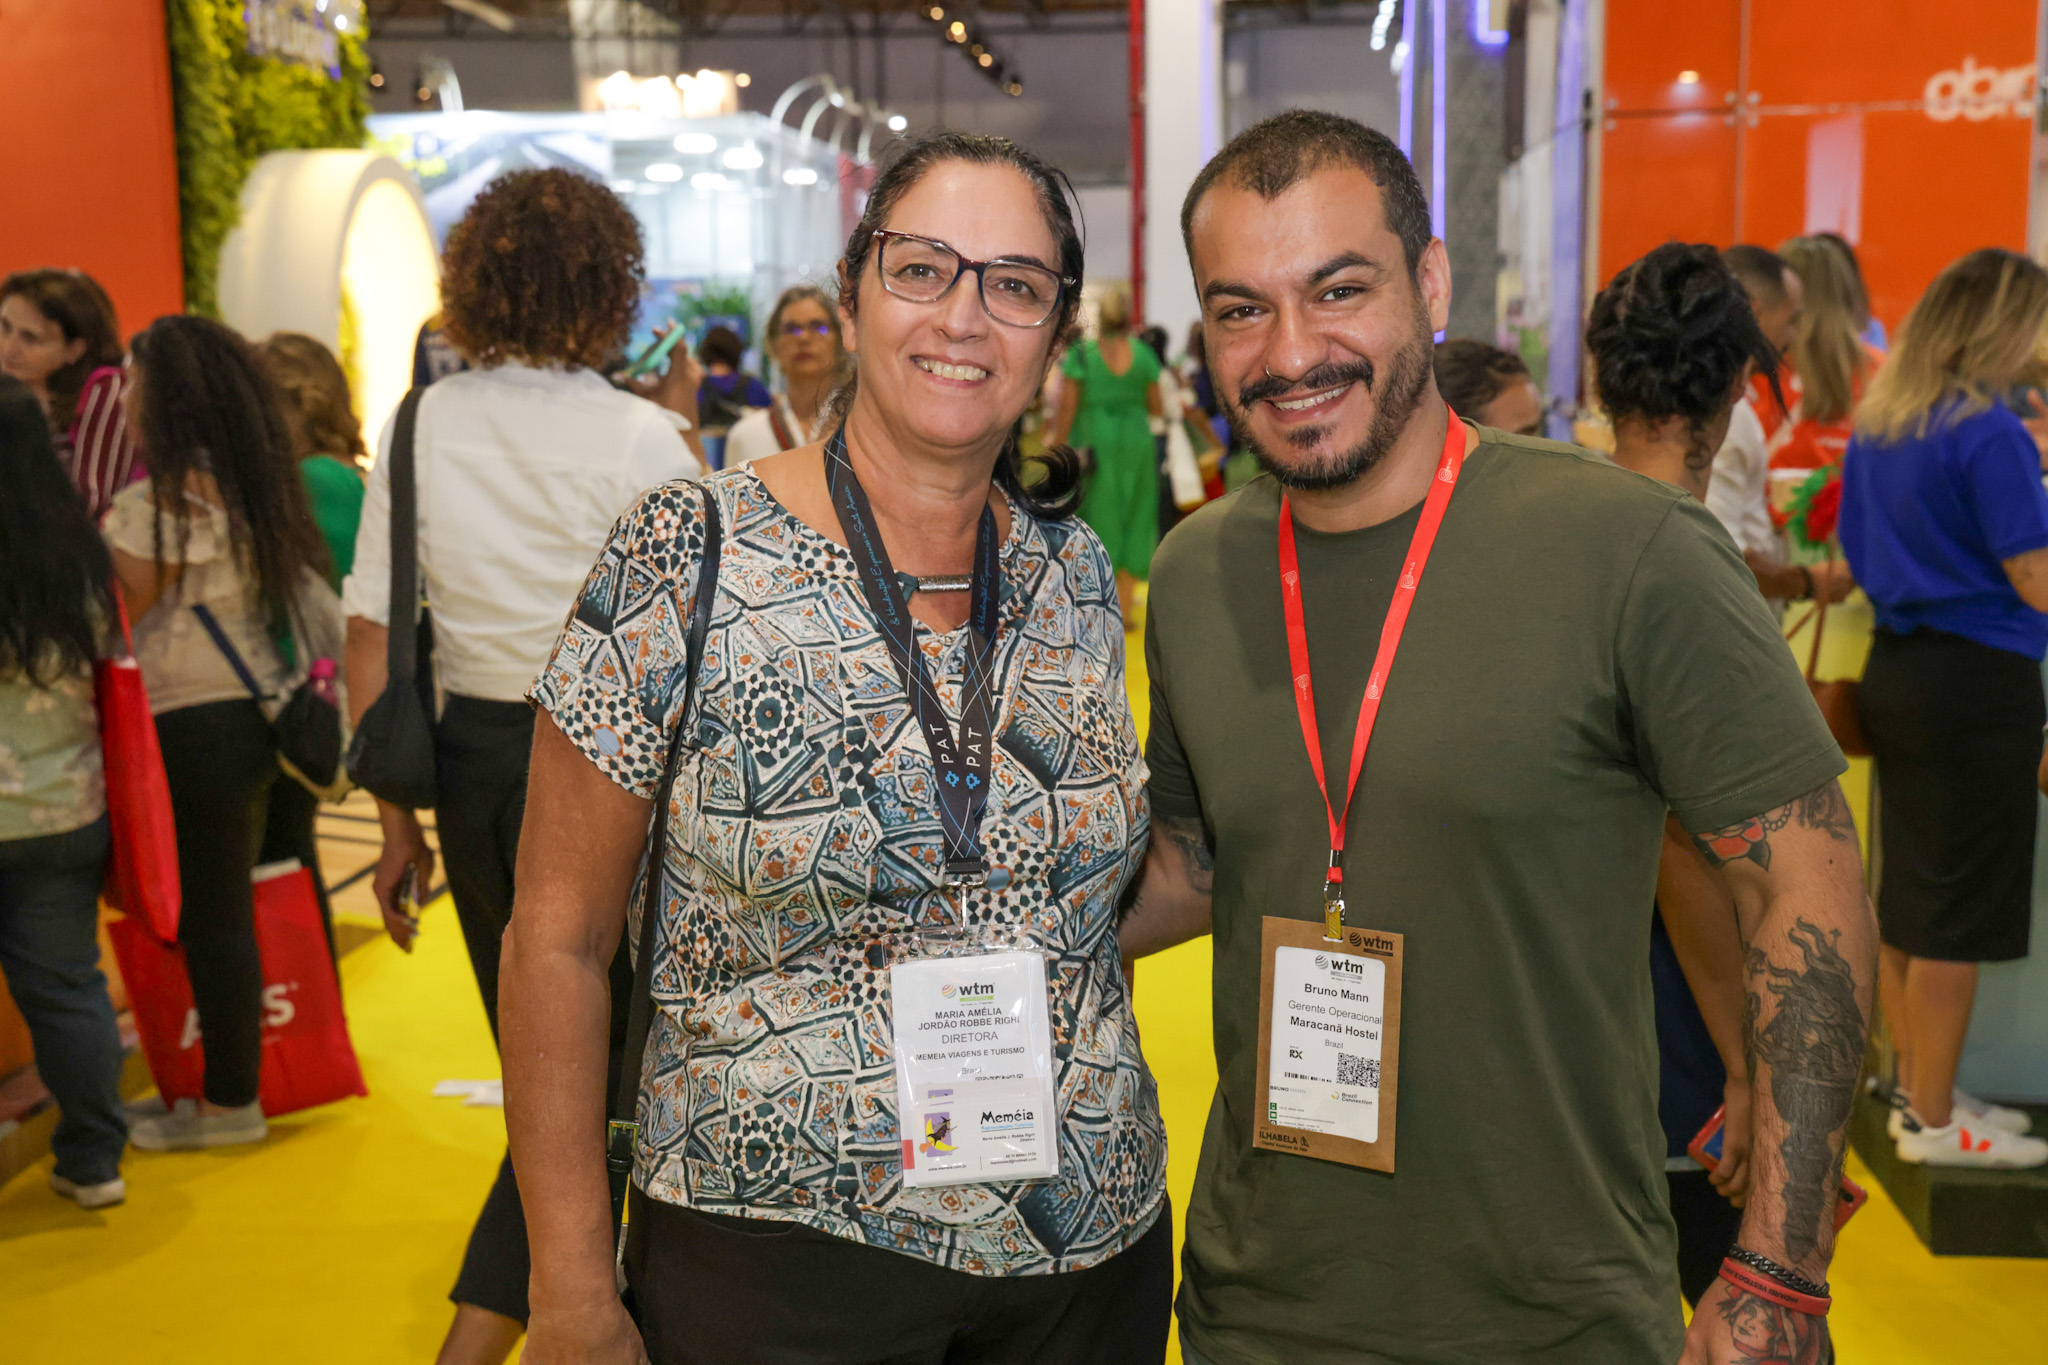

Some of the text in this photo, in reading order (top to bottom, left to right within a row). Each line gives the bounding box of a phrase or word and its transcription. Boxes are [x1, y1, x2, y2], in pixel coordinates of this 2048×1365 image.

[844, 485, 858, 513] America
[852, 512, 865, 533] South
[865, 539, 883, 576] Experiences
[875, 577, 895, 616] Handcrafted
[929, 723, 954, 763] PAT
[966, 726, 982, 767] PAT
[1363, 936, 1393, 951] wtm
[1331, 959, 1363, 974] wtm
[959, 982, 994, 996] wtm
[1304, 983, 1369, 1003] Bruno Mann
[935, 1006, 1002, 1020] MARIA AMÉLIA
[1288, 1000, 1382, 1025] Gerente Operacional
[918, 1016, 1020, 1030] JORDÃO ROBBE RIGHI
[1290, 1016, 1378, 1040] Maracanã Hostel
[941, 1031, 998, 1044] DIRETORA
[1324, 1039, 1344, 1049] Brazil
[916, 1052, 946, 1061] MEMEIA
[948, 1050, 982, 1059] VIAGENS
[991, 1046, 1025, 1056] TURISMO
[1289, 1049, 1303, 1059] RX
[1341, 1097, 1372, 1105] Connection
[980, 1109, 1034, 1125] Meméia
[1259, 1131, 1298, 1144] ILHABELA
[1739, 1275, 1767, 1291] VESTIDO
